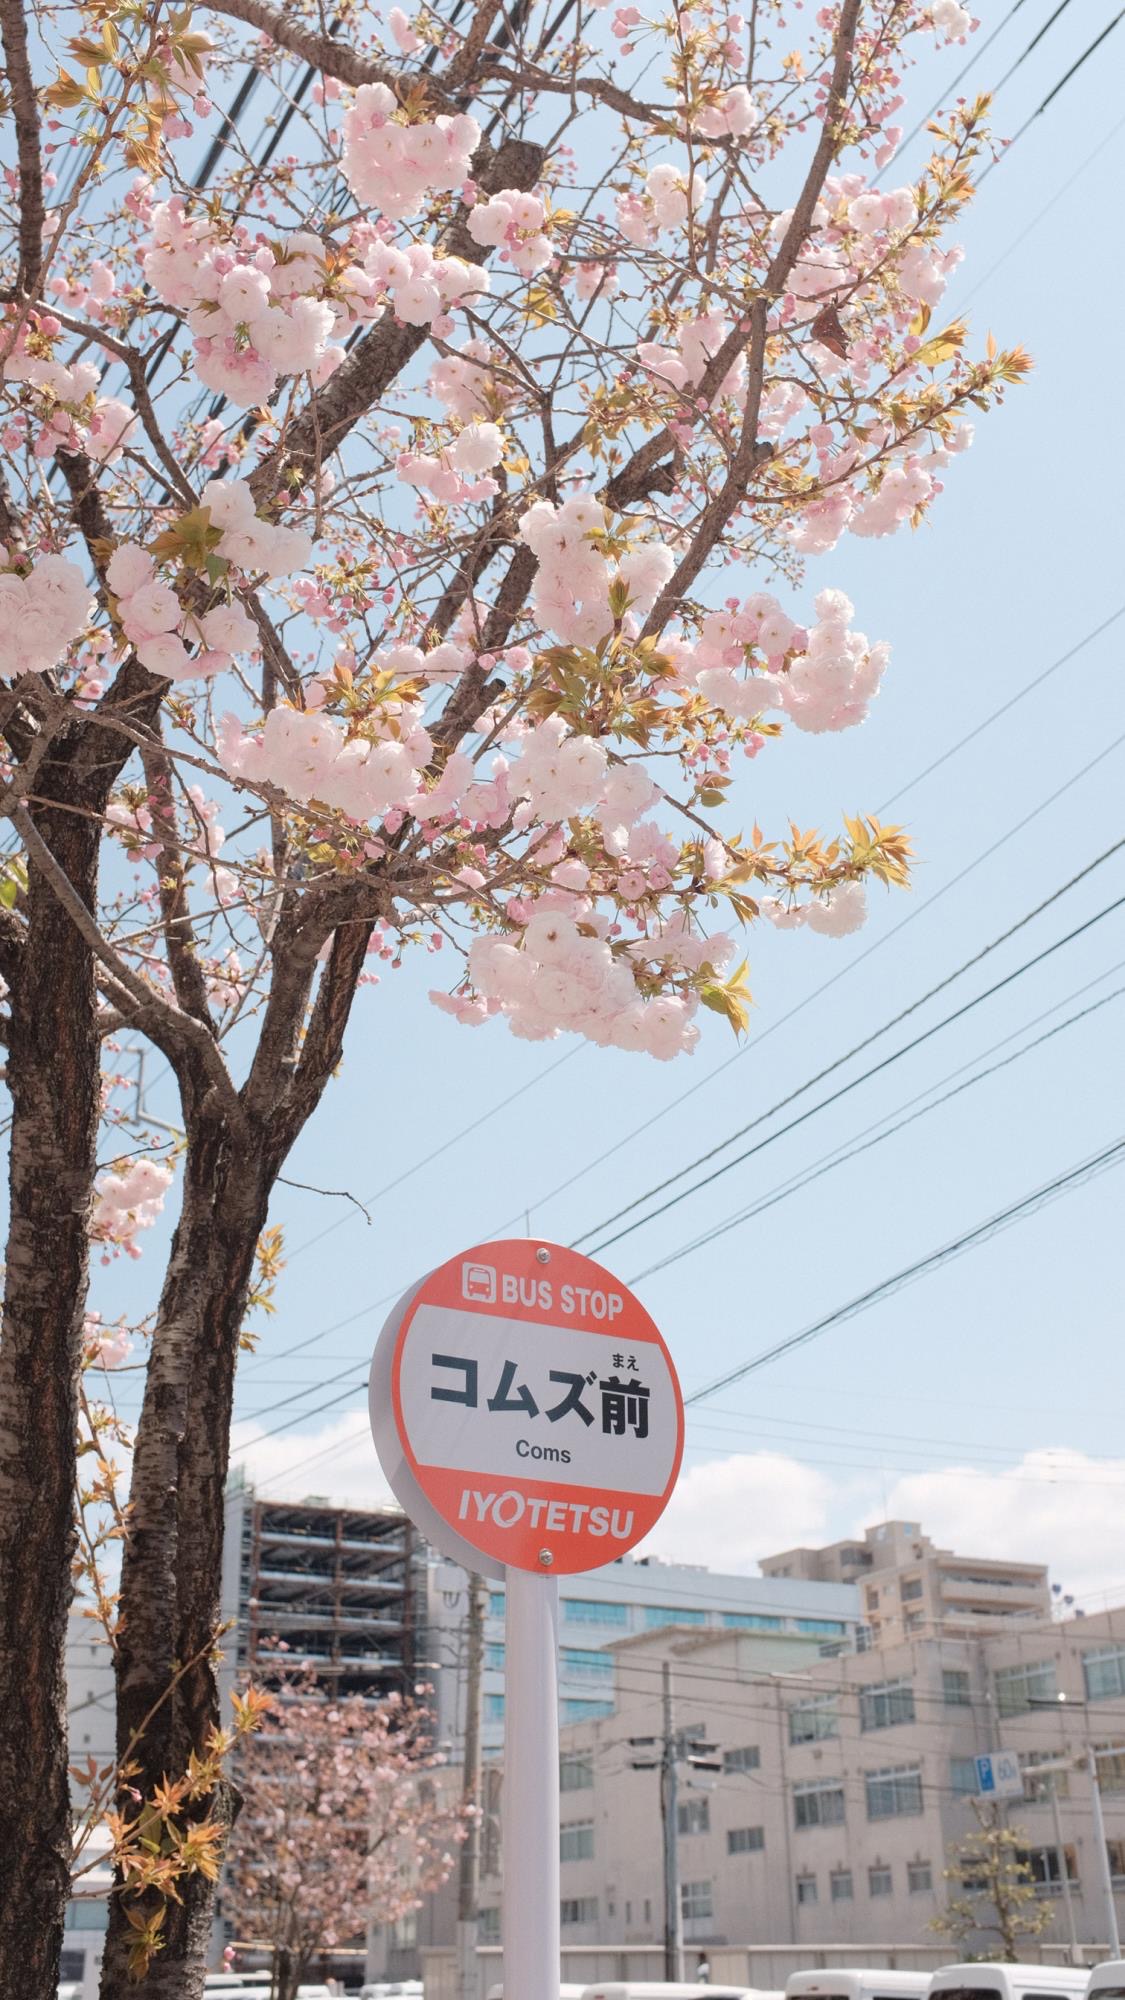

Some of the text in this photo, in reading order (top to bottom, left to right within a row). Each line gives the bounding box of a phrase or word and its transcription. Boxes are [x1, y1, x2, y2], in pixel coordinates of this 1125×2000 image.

[502, 1274, 623, 1320] BUS STOP
[612, 1353, 639, 1372] まえ
[431, 1353, 650, 1439] コムズ前
[515, 1440, 571, 1463] Coms
[458, 1489, 634, 1539] IYOTETSU
[980, 1759, 989, 1779] P
